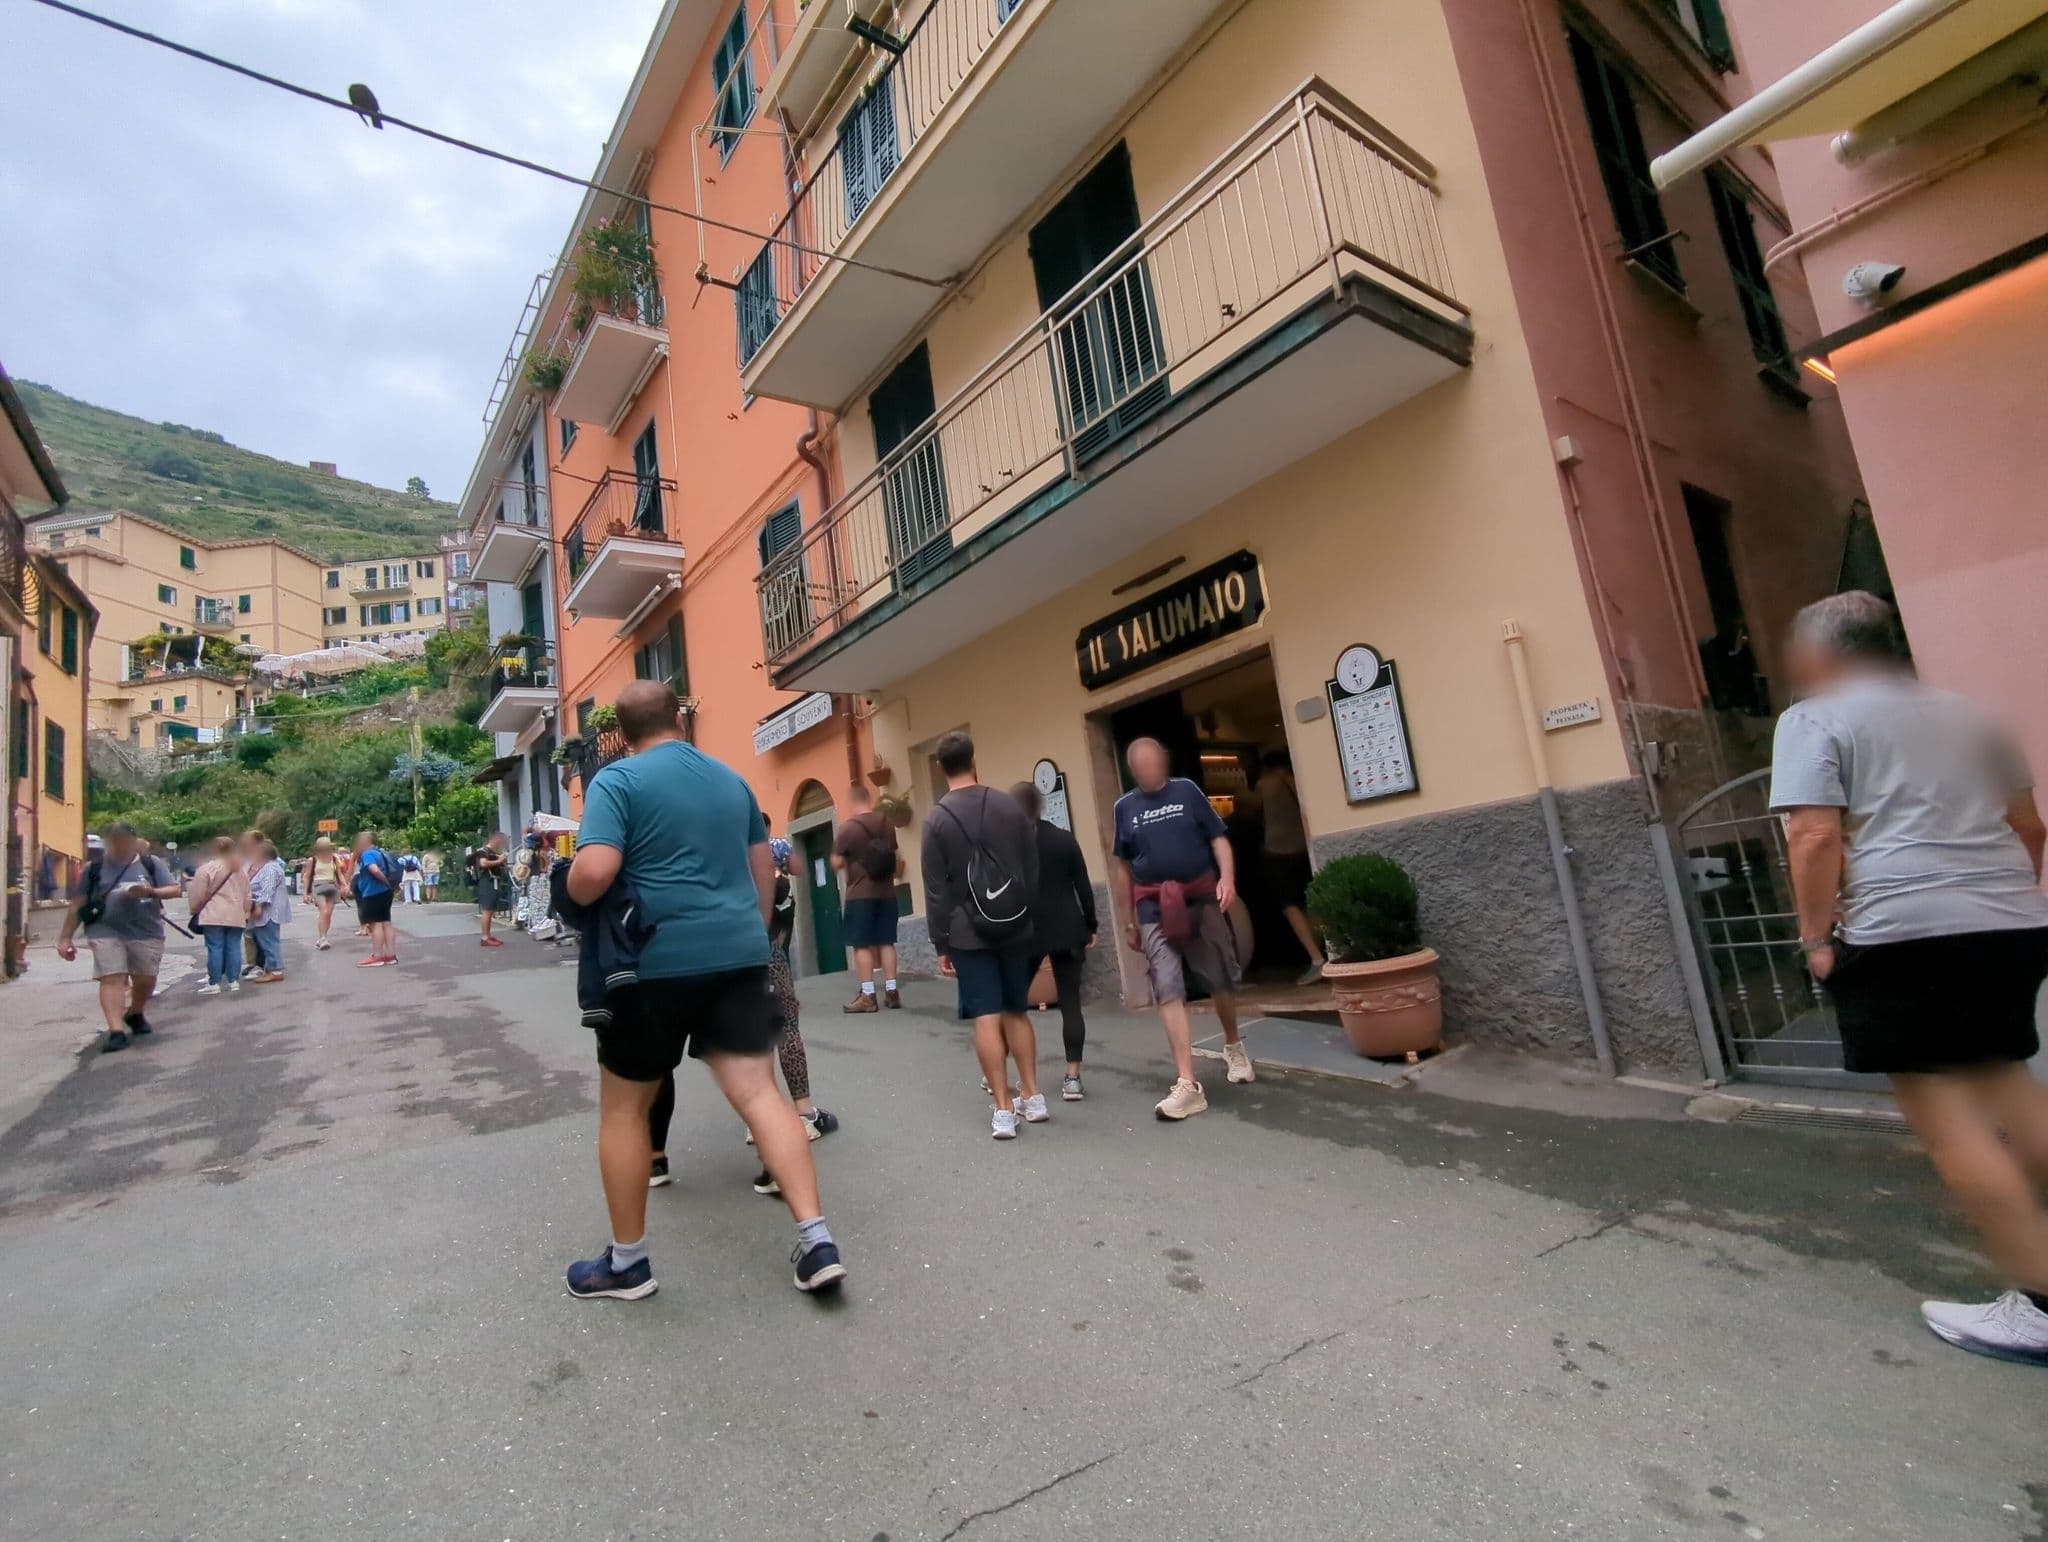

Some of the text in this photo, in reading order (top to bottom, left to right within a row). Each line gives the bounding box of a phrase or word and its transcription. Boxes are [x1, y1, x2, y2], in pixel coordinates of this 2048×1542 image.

[1088, 571, 1245, 675] IL SALUMAIO
[1556, 713, 1585, 724] PRIVATA
